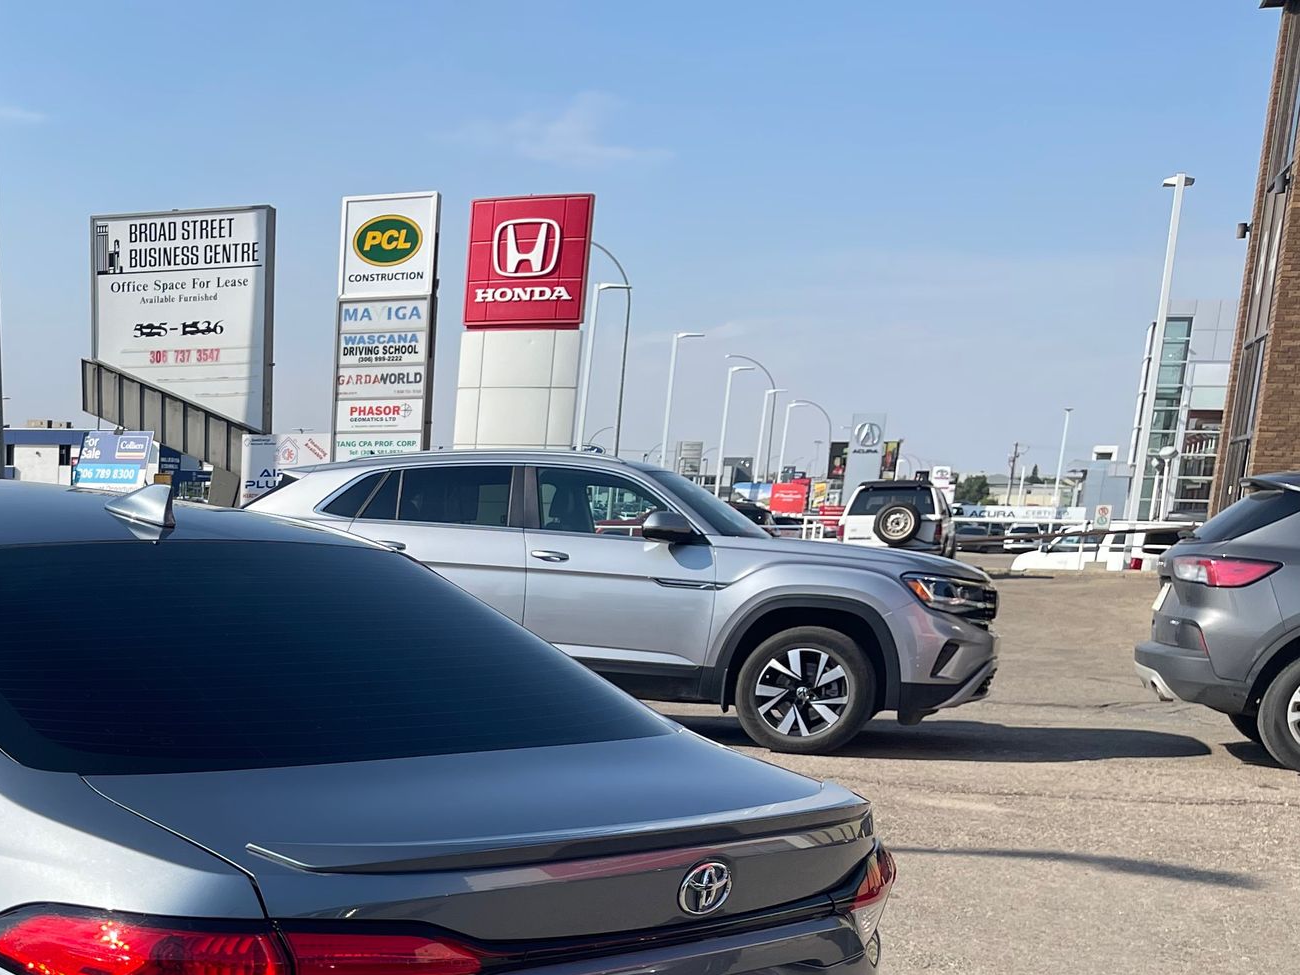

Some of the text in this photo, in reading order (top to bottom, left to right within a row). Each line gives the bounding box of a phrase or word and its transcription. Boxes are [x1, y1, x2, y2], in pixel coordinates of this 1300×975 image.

[129, 218, 235, 243] BROAD STREET
[363, 229, 412, 251] PCL
[129, 242, 259, 268] BUSINESS CENTRE
[348, 272, 425, 283] CONSTRUCTION
[110, 276, 249, 293] Office Space For Lease
[140, 293, 218, 305] Available Furnished
[474, 286, 573, 303] HONDA
[343, 333, 419, 346] WASCANA
[150, 348, 221, 364] 306 737 3547
[343, 344, 419, 357] DRIVING SCHOOL
[337, 372, 422, 386] GARDAWORLD
[349, 406, 401, 416] PHASOR
[80, 448, 101, 459] Sale
[95, 469, 111, 479] 789
[112, 469, 135, 479] 8300
[970, 510, 1015, 518] ACURA
